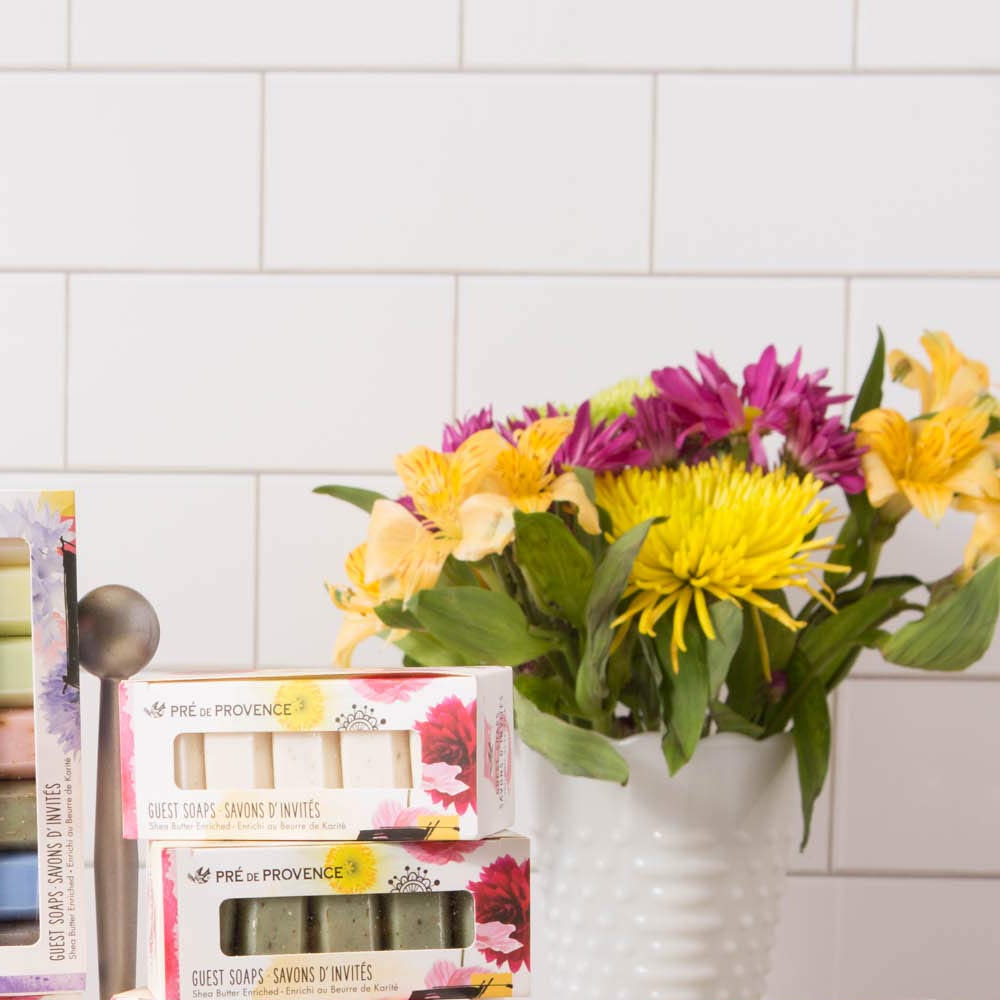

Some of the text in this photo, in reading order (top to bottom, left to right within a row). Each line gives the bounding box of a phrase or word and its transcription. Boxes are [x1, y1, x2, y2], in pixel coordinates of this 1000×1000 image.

[171, 701, 291, 717] PRÉ DE PROVENCE
[64, 785, 72, 794] de
[65, 798, 73, 823] Beurre
[149, 802, 178, 819] GUEST
[183, 802, 216, 819] SOAPS
[225, 802, 264, 818] SAVONS
[68, 827, 73, 837] au
[47, 843, 63, 883] SAVONS
[216, 867, 343, 882] PRÉ DE PROVENCE
[67, 876, 75, 910] Enriched
[47, 891, 64, 924] SOAPS
[68, 914, 76, 936] Butter
[49, 931, 65, 960] GUEST
[192, 970, 224, 986] GUEST
[230, 968, 264, 985] SOAPS
[274, 967, 315, 984] SAVONS
[193, 990, 213, 998] Shea
[216, 989, 239, 997] Butter
[243, 988, 278, 996] Enriched
[286, 987, 314, 995] Enrichi
[374, 984, 398, 992] Karité
